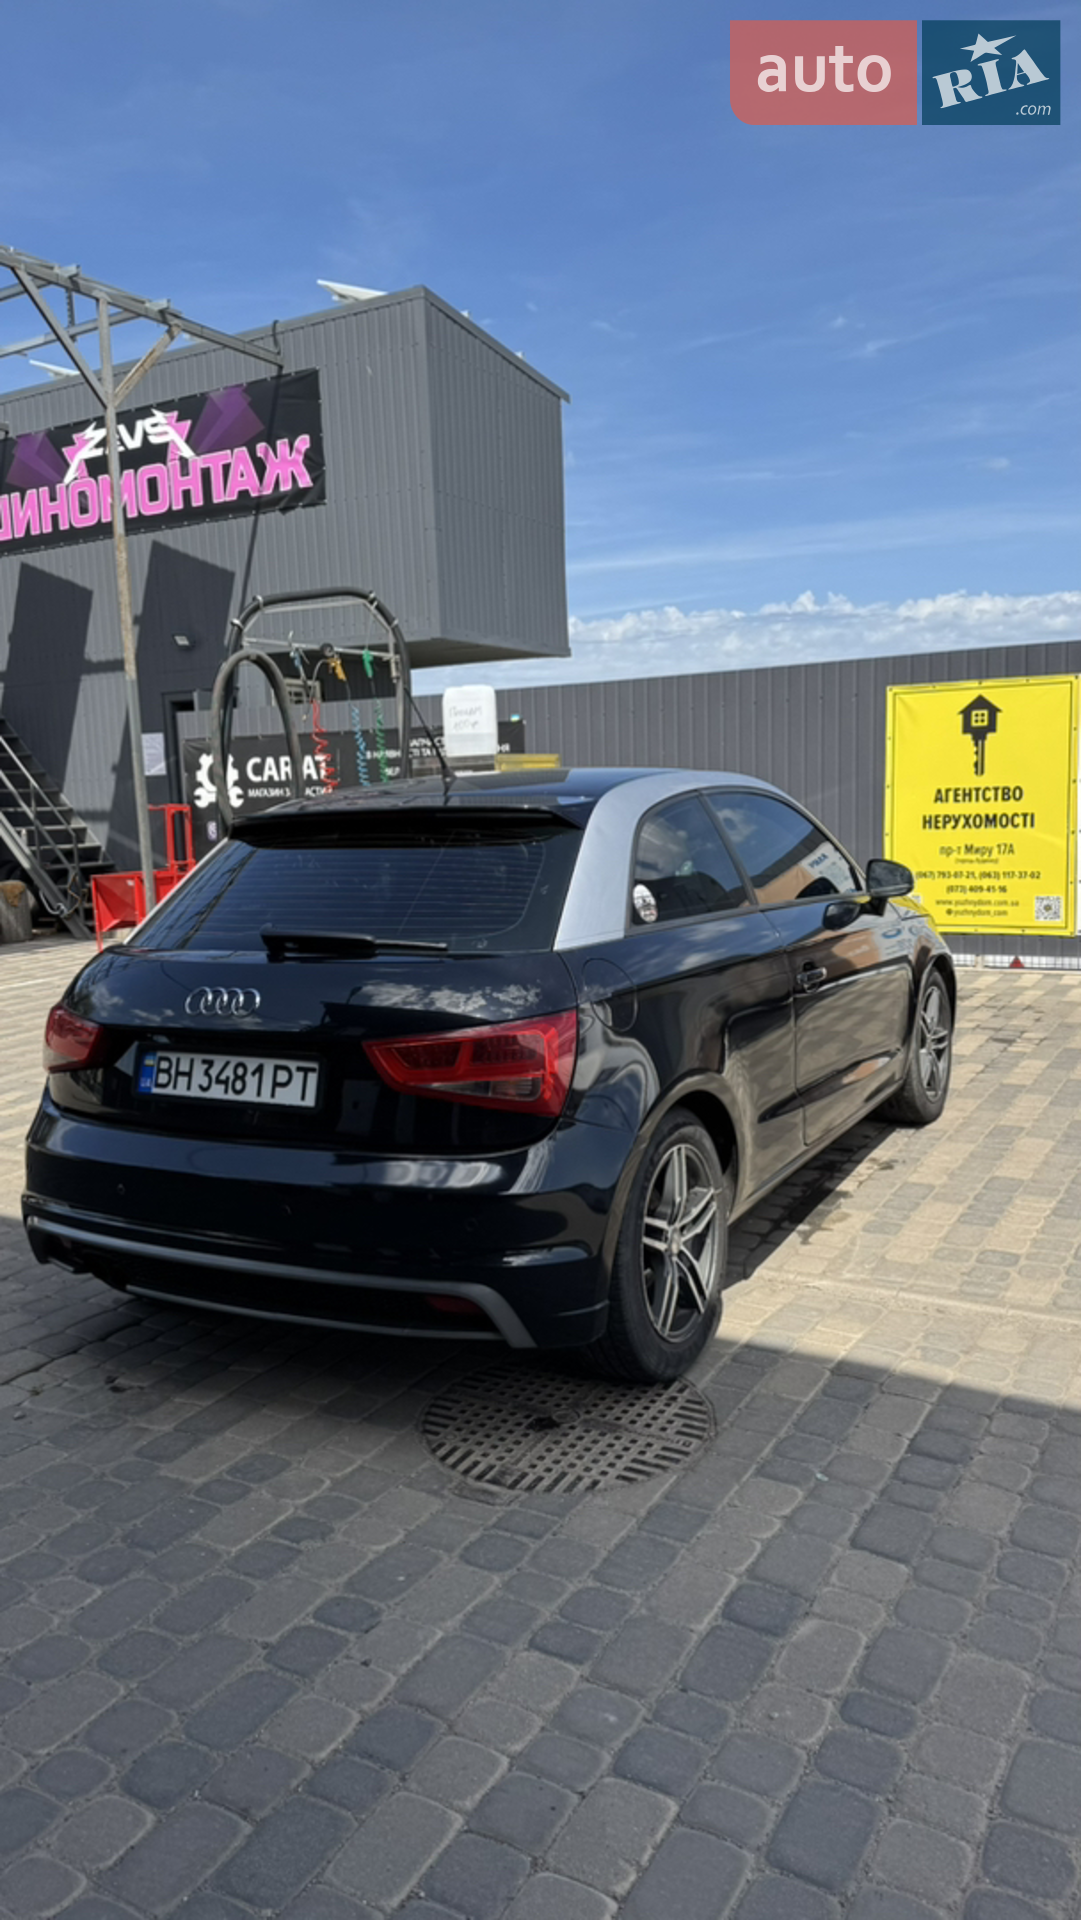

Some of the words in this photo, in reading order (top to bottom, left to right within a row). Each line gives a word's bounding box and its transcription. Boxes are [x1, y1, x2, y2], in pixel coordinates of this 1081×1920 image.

[247, 786, 283, 798] МАГАЗИН
[933, 785, 1024, 804] АГЕНТСТВО
[922, 812, 1035, 830] НЕРУХОМОСТІ
[939, 845, 962, 857] пр-т
[964, 843, 993, 857] Миру
[996, 843, 1015, 855] 17А
